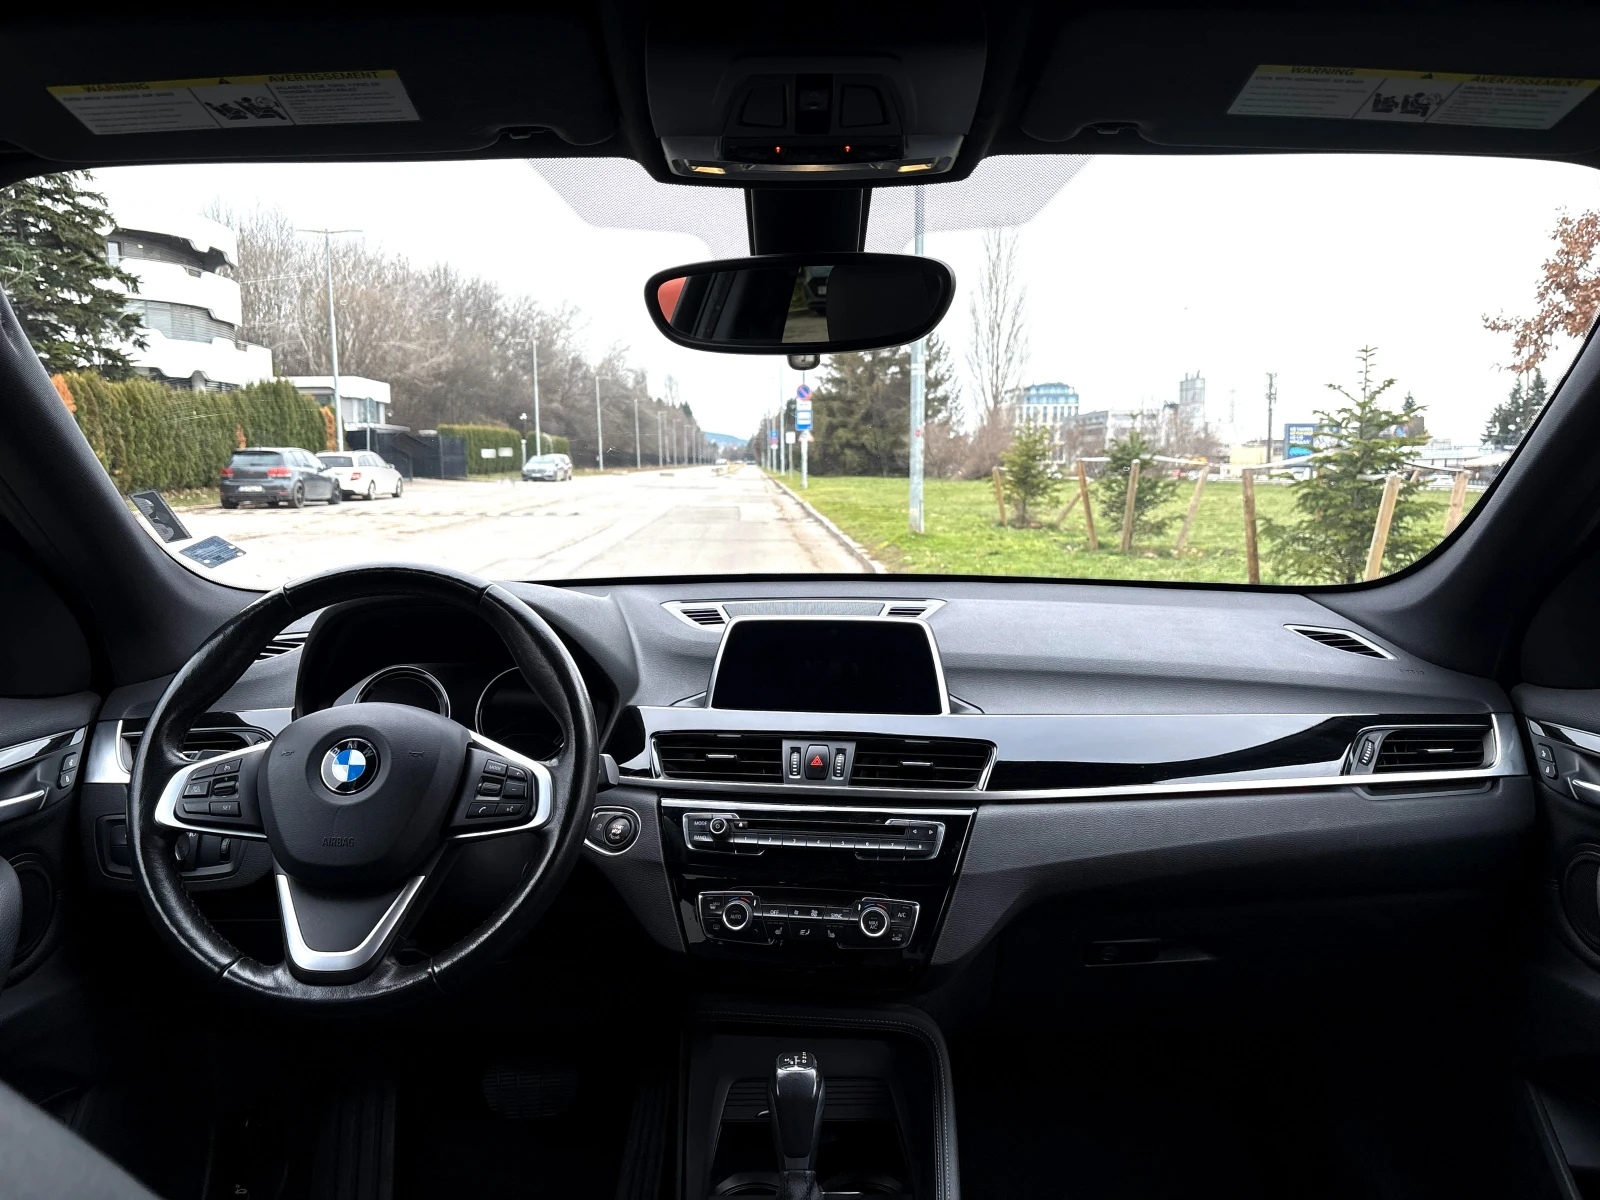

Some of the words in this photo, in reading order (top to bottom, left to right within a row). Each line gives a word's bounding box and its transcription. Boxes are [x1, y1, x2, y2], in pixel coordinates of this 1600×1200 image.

[268, 71, 379, 83] AVERTISSEMENT
[1290, 66, 1355, 76] WARNING
[1470, 75, 1587, 87] AVERTISSEMENT
[83, 82, 150, 93] WARNING
[322, 836, 356, 848] AIRBAG
